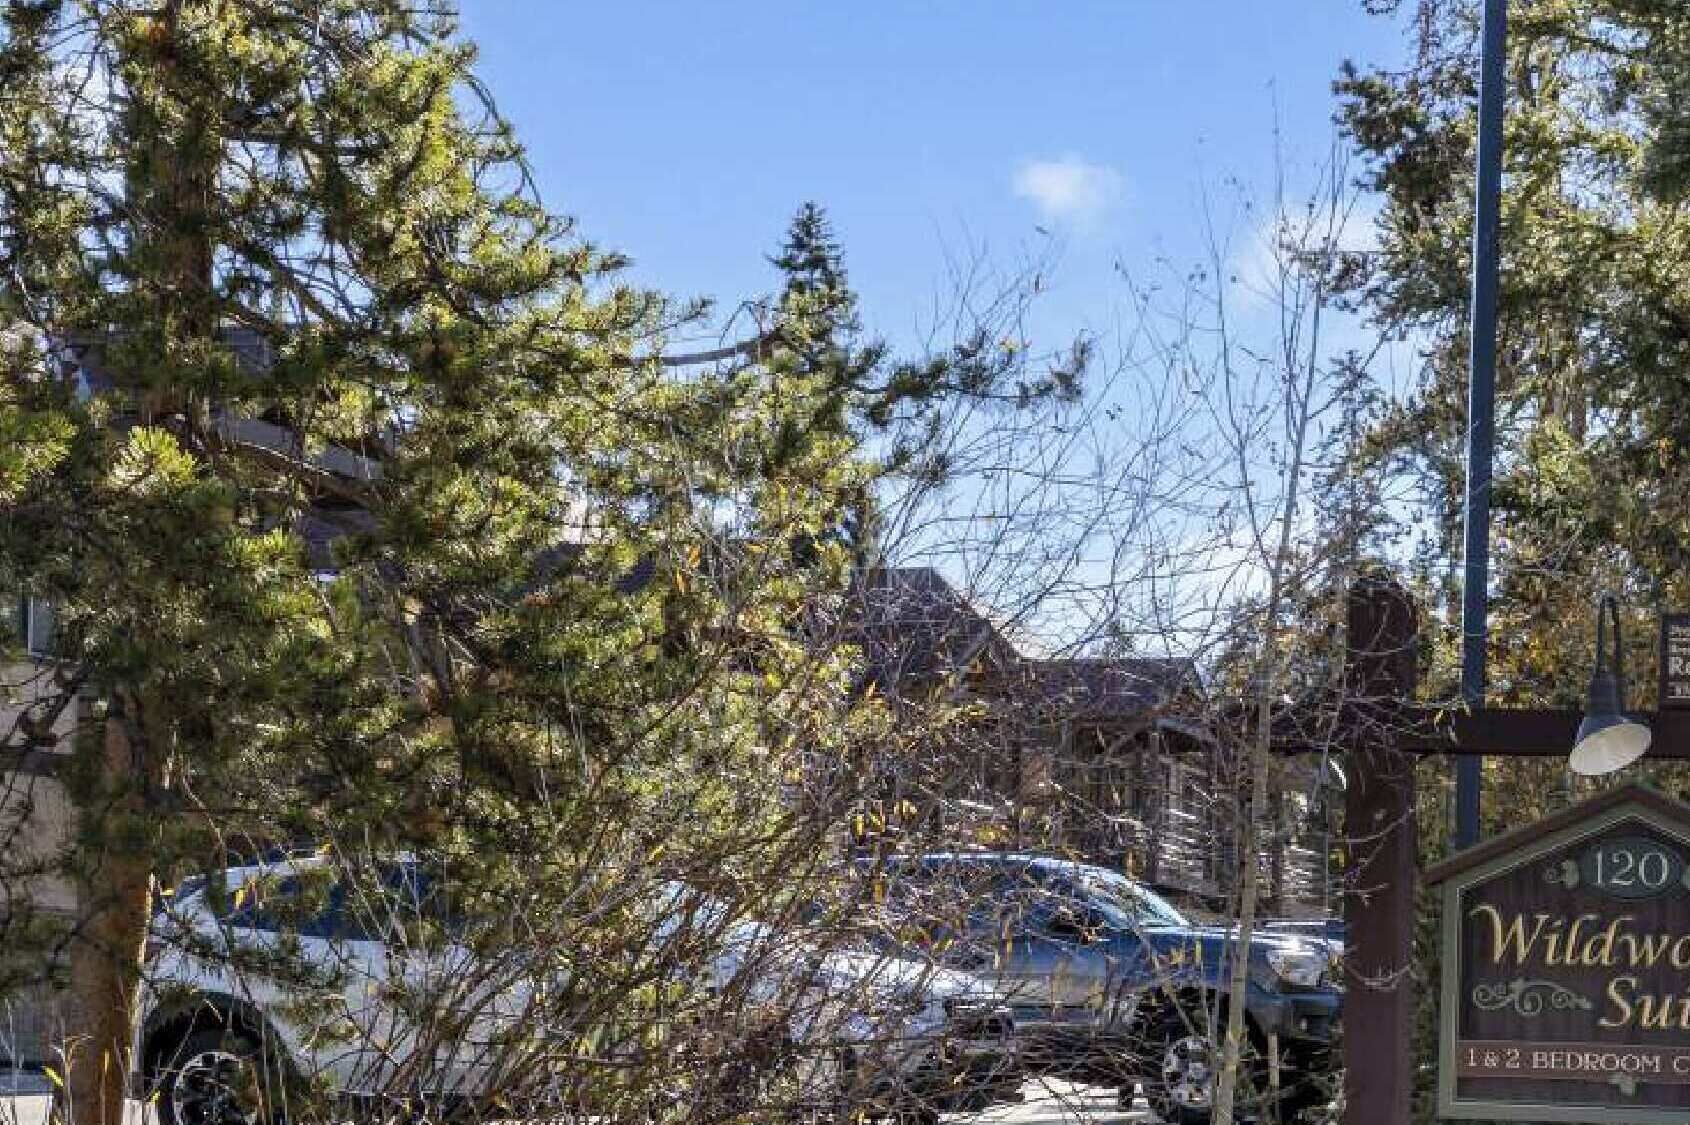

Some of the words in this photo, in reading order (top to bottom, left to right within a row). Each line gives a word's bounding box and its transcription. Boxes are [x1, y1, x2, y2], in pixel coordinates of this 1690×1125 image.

[1593, 851, 1669, 887] 120
[1465, 1048, 1477, 1067] 1
[1484, 1051, 1498, 1068] &
[1504, 1048, 1521, 1069] 2
[1531, 1051, 1661, 1073] BEDROOM
